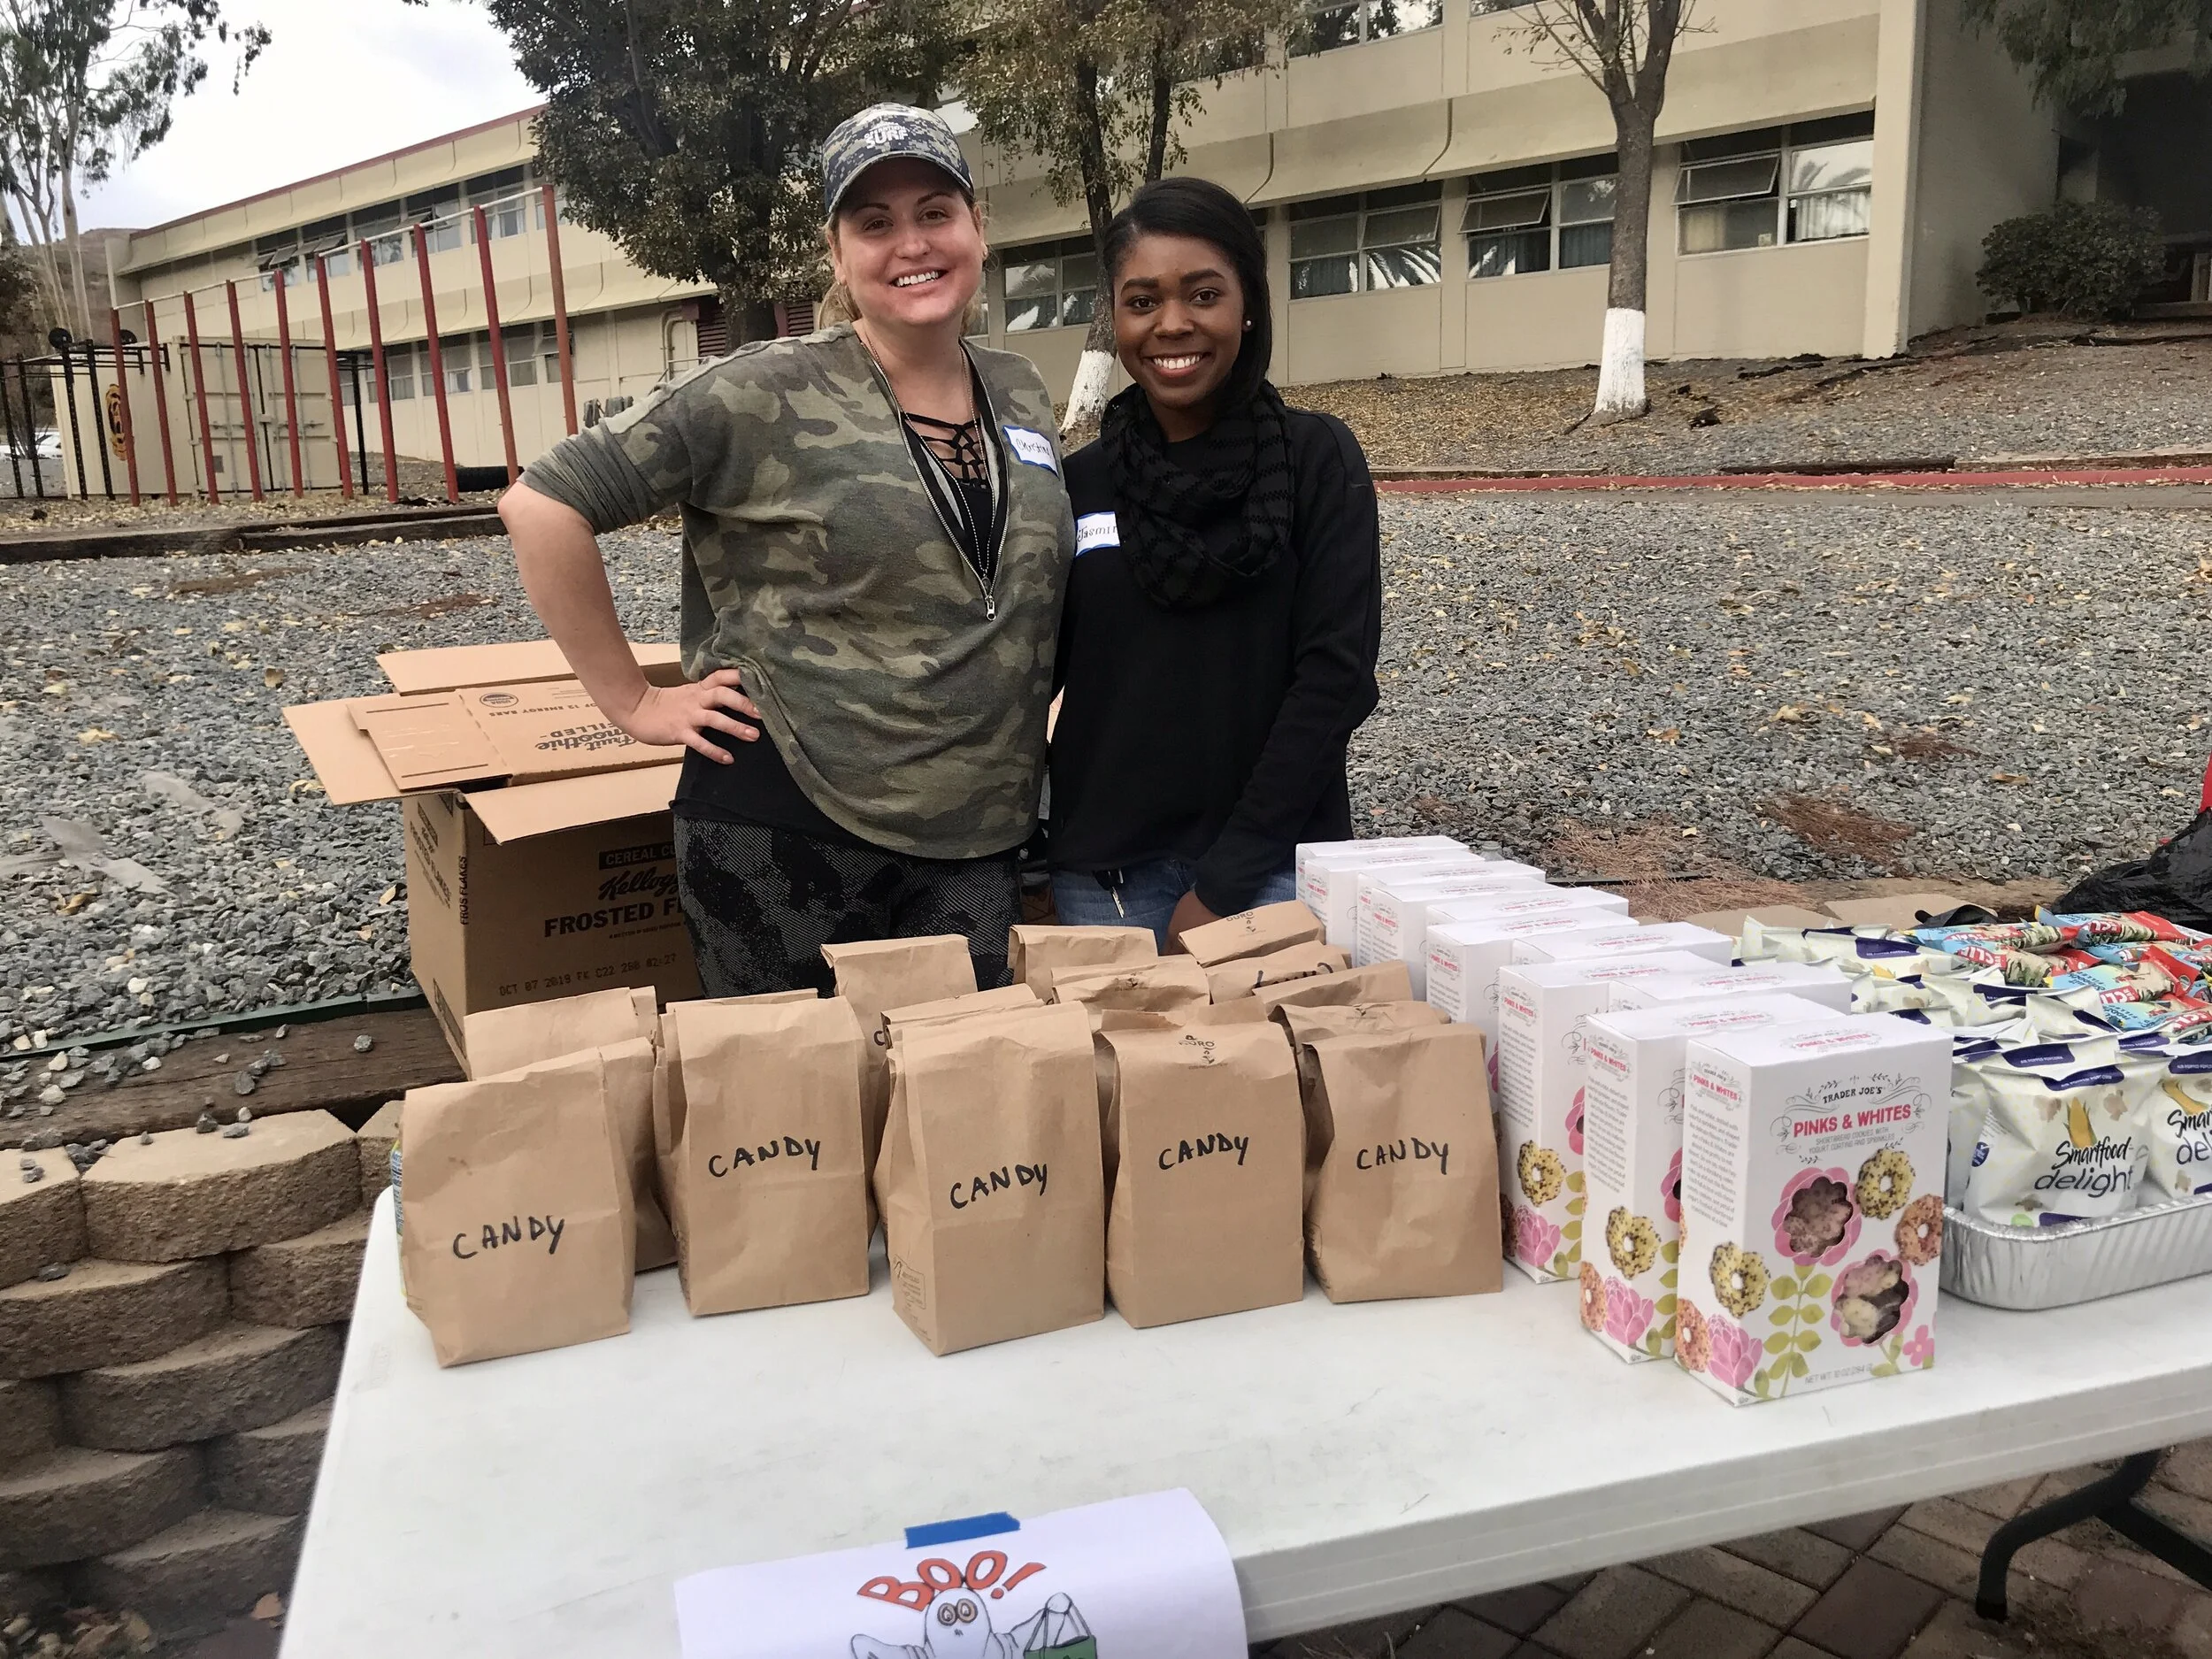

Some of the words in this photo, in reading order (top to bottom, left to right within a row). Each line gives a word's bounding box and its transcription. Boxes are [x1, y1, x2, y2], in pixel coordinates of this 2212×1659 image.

[522, 705, 564, 715] ENERGY
[534, 728, 623, 752] moothie
[605, 847, 657, 865] CEREAL
[661, 844, 676, 856] CU
[458, 856, 468, 896] FLAKES
[597, 866, 679, 901] Kellogg
[544, 902, 655, 938] FROSTED
[499, 984, 518, 996] OCT
[2100, 991, 2128, 1004] CLI
[1609, 1056, 1626, 1072] WHITES
[1694, 1074, 1709, 1087] PINKS
[1716, 1085, 1738, 1101] WHITES
[1823, 1087, 1856, 1104] TRADER
[1858, 1086, 1883, 1095] JOE'S
[1793, 1116, 1838, 1138] PINKS
[1842, 1113, 1853, 1130] &
[1857, 1103, 1911, 1127] WHITES
[709, 1136, 821, 1178] CANDY
[1158, 1132, 1249, 1171] CANDY
[1356, 1137, 1448, 1175] CANDY
[1809, 1145, 1829, 1155] YOGURT
[1866, 1133, 1895, 1145] SPRINKLES
[2051, 1136, 2131, 1170] Smartfood
[2177, 1132, 2212, 1165] del
[949, 1164, 1048, 1210] CANDY
[2034, 1164, 2134, 1198] delight
[452, 1215, 565, 1259] CANDY
[856, 1549, 1048, 1613] BOO!
